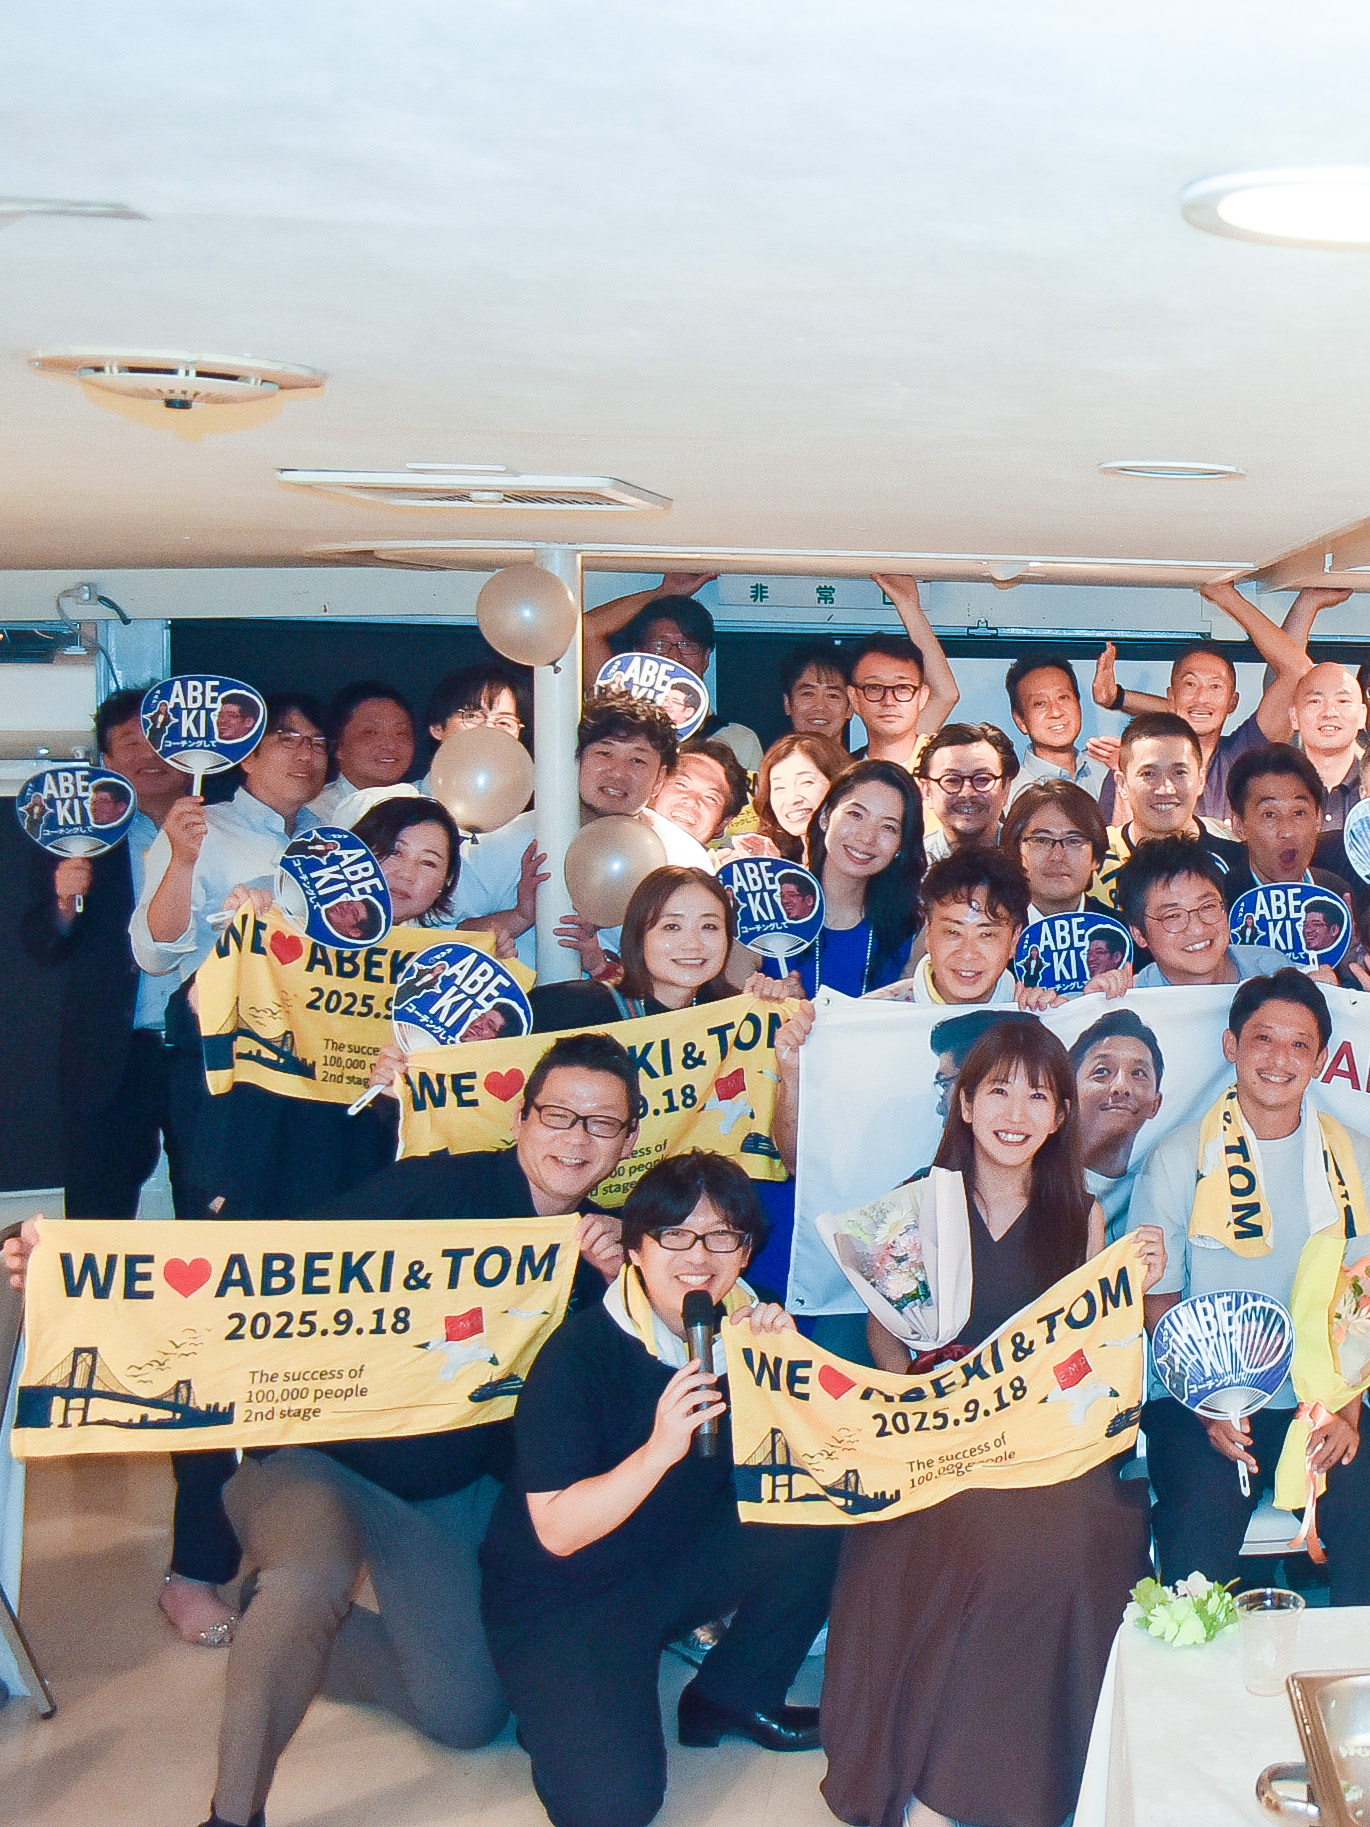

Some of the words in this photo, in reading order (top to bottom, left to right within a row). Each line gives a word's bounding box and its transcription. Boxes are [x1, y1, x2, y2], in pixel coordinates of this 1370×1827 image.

[624, 656, 675, 693] ABE
[168, 680, 221, 709] ABE
[181, 710, 208, 738] KI
[43, 771, 91, 800] ABE
[56, 799, 83, 826] KI
[310, 865, 348, 896] KI
[337, 849, 385, 901] ABE
[732, 861, 777, 893] ABE
[747, 892, 775, 921] KI
[1255, 888, 1302, 920] ABE
[1040, 917, 1086, 952] ABE
[1268, 920, 1293, 950] KI
[446, 952, 511, 1009] ABE
[1053, 950, 1077, 981] KI
[429, 985, 474, 1027] KI
[322, 1055, 366, 1070] 100,000
[323, 1038, 345, 1052] The
[347, 1044, 380, 1056] succe
[682, 1042, 706, 1069] &
[321, 1070, 344, 1084] 2nd
[345, 1075, 370, 1089] stag
[405, 1071, 479, 1112] WE
[1225, 1136, 1264, 1240] TOM
[59, 1251, 155, 1300] WE
[215, 1250, 394, 1299] ABEKI
[402, 1260, 432, 1291] &
[440, 1243, 561, 1290] TOM
[224, 1306, 411, 1341] 2025.9.18
[742, 1347, 812, 1401] WE
[1011, 1332, 1036, 1362] &
[1037, 1266, 1133, 1344] TOM
[249, 1369, 279, 1384] The
[283, 1367, 345, 1383] success
[348, 1364, 365, 1380] of
[245, 1387, 309, 1405] 100,000
[313, 1383, 368, 1403] people
[243, 1407, 275, 1423] 2nd
[279, 1406, 321, 1423] stage
[906, 1458, 934, 1473] The
[938, 1442, 991, 1464] success
[993, 1431, 1006, 1448] of
